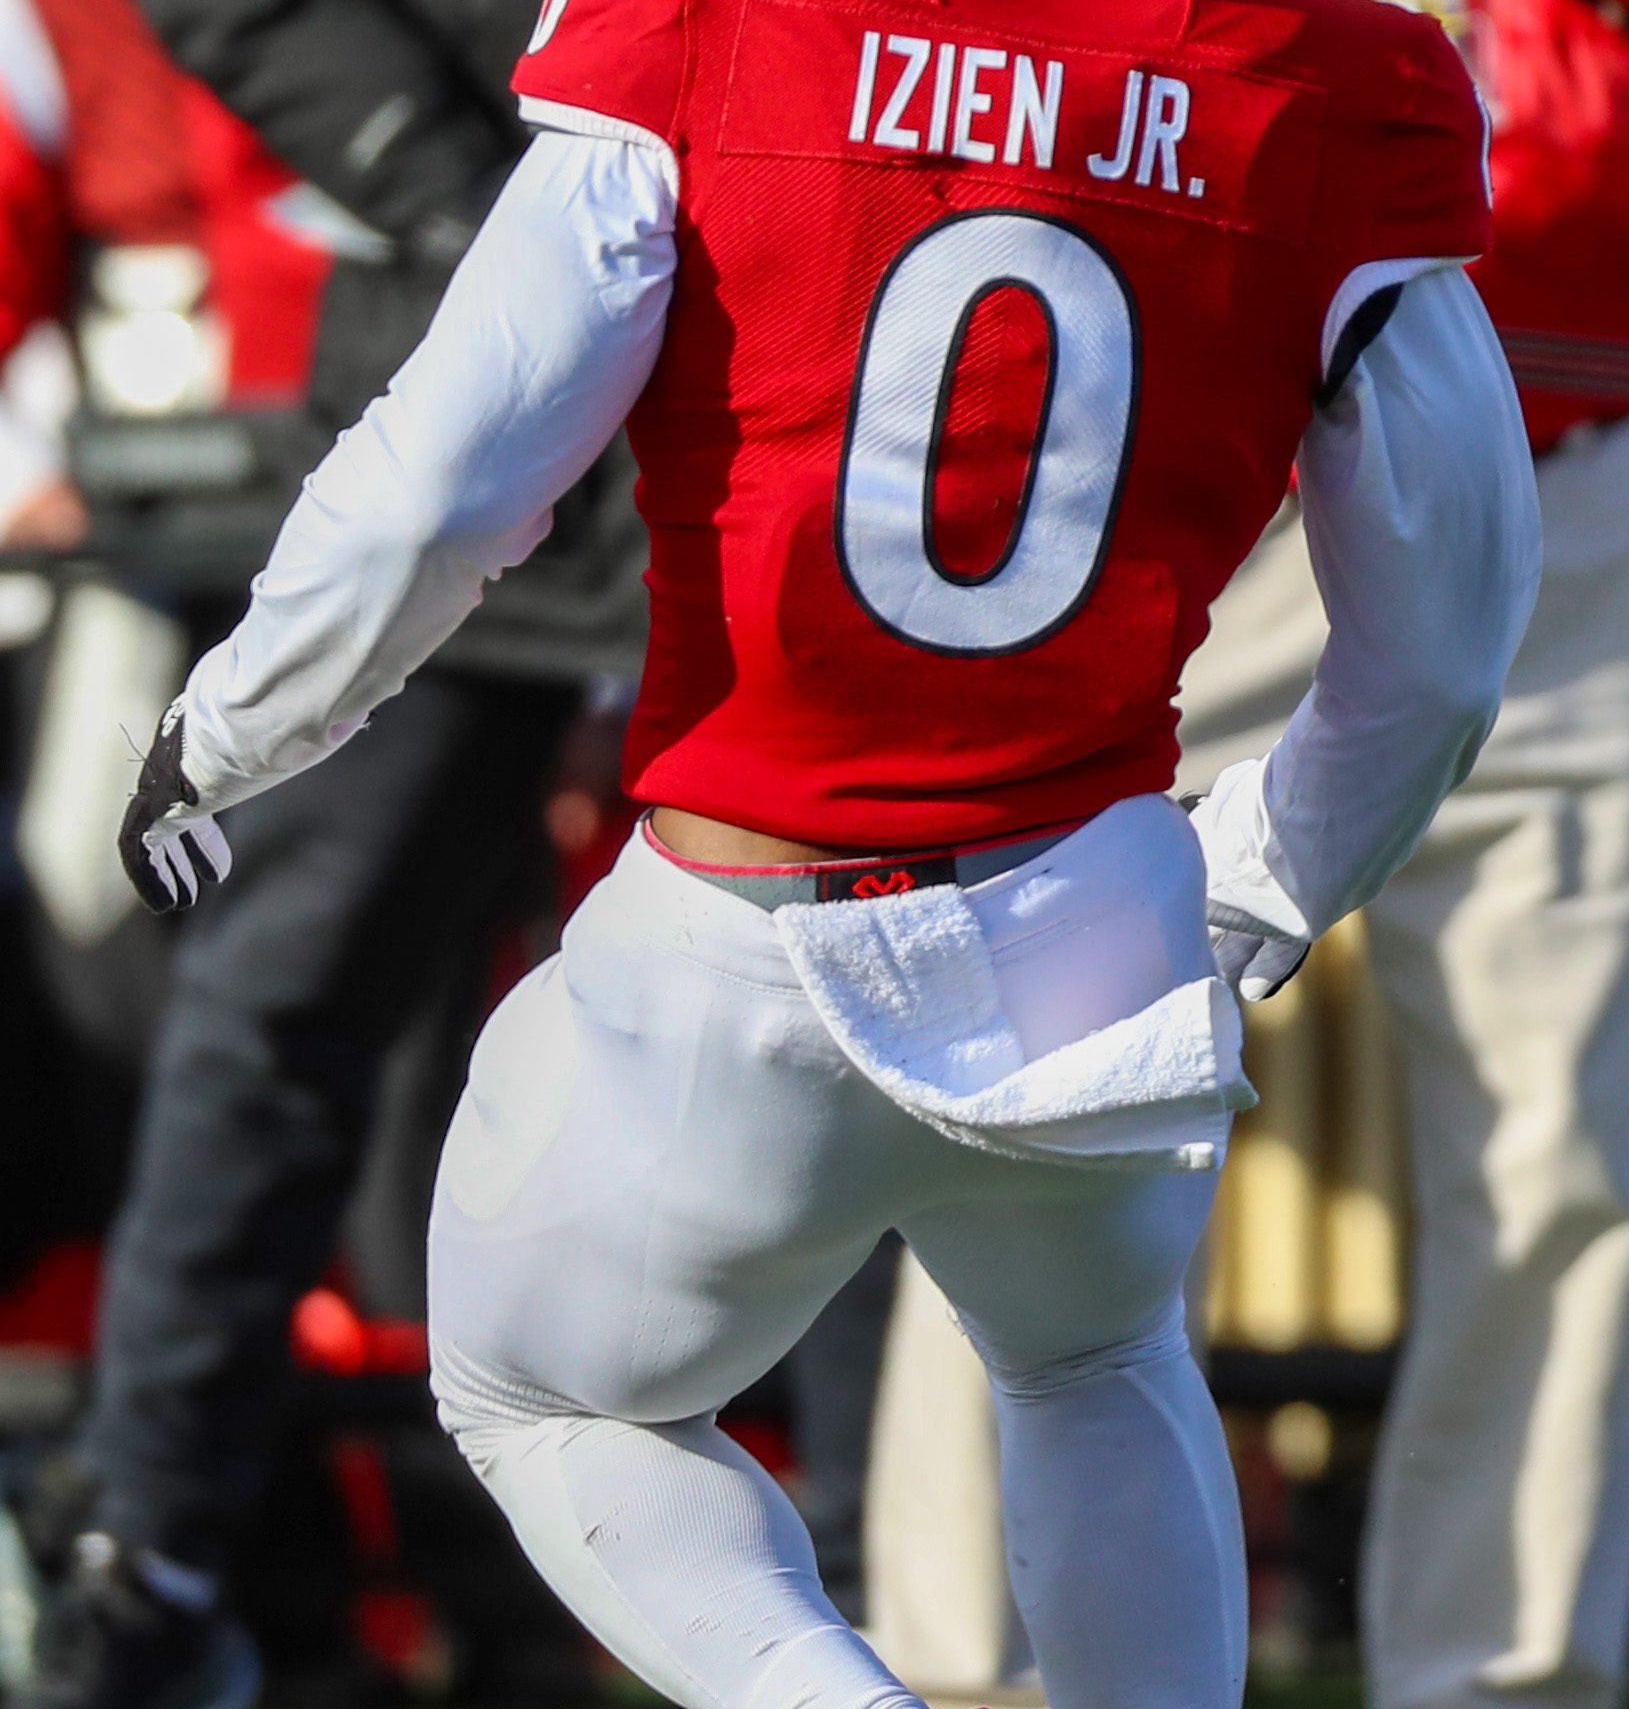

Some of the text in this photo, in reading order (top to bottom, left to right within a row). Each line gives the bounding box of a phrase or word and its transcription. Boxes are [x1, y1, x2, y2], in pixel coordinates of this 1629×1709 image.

[848, 30, 1206, 198] IZIEN JR.
[833, 206, 1143, 659] 0
